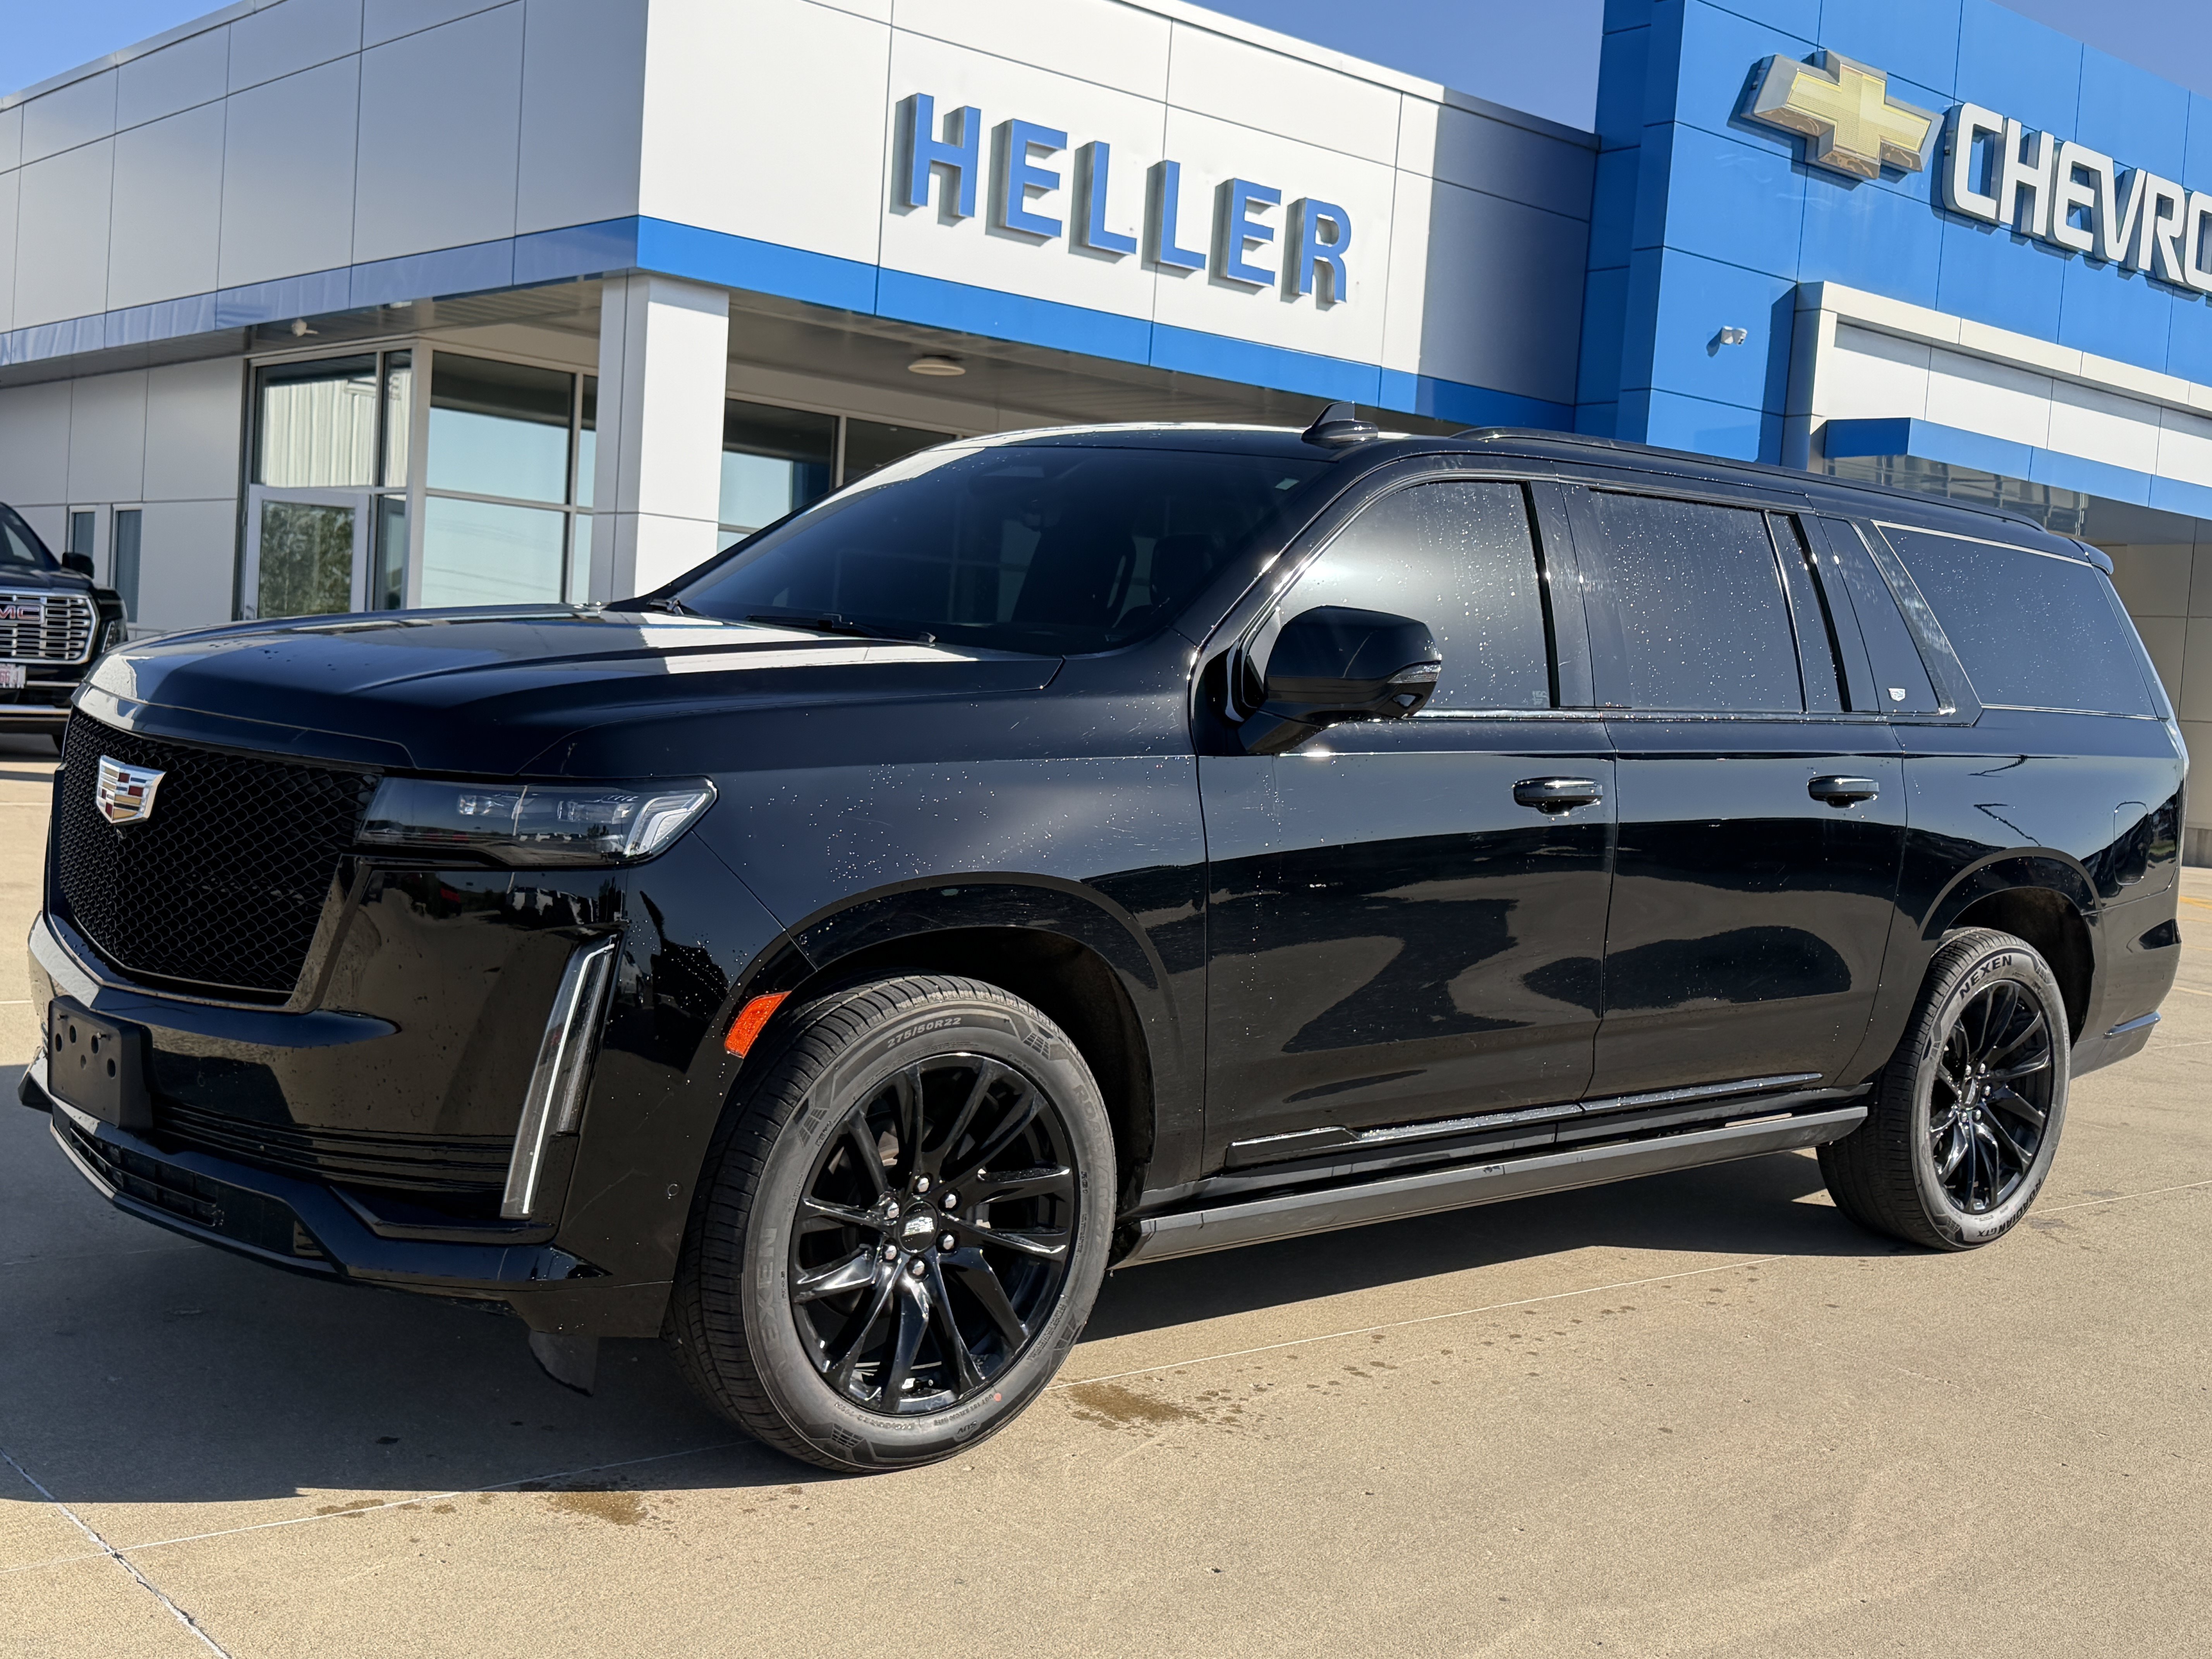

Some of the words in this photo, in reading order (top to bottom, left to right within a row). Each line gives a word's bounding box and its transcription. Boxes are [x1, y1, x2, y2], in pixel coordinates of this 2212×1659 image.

[906, 92, 1352, 304] HELLER
[1960, 955, 2012, 1000] NEXEN
[887, 1017, 962, 1048] 275/50R22
[1998, 1178, 2042, 1234] ROADIAN
[1977, 1227, 1997, 1237] GTX
[957, 1420, 977, 1435] SUV
